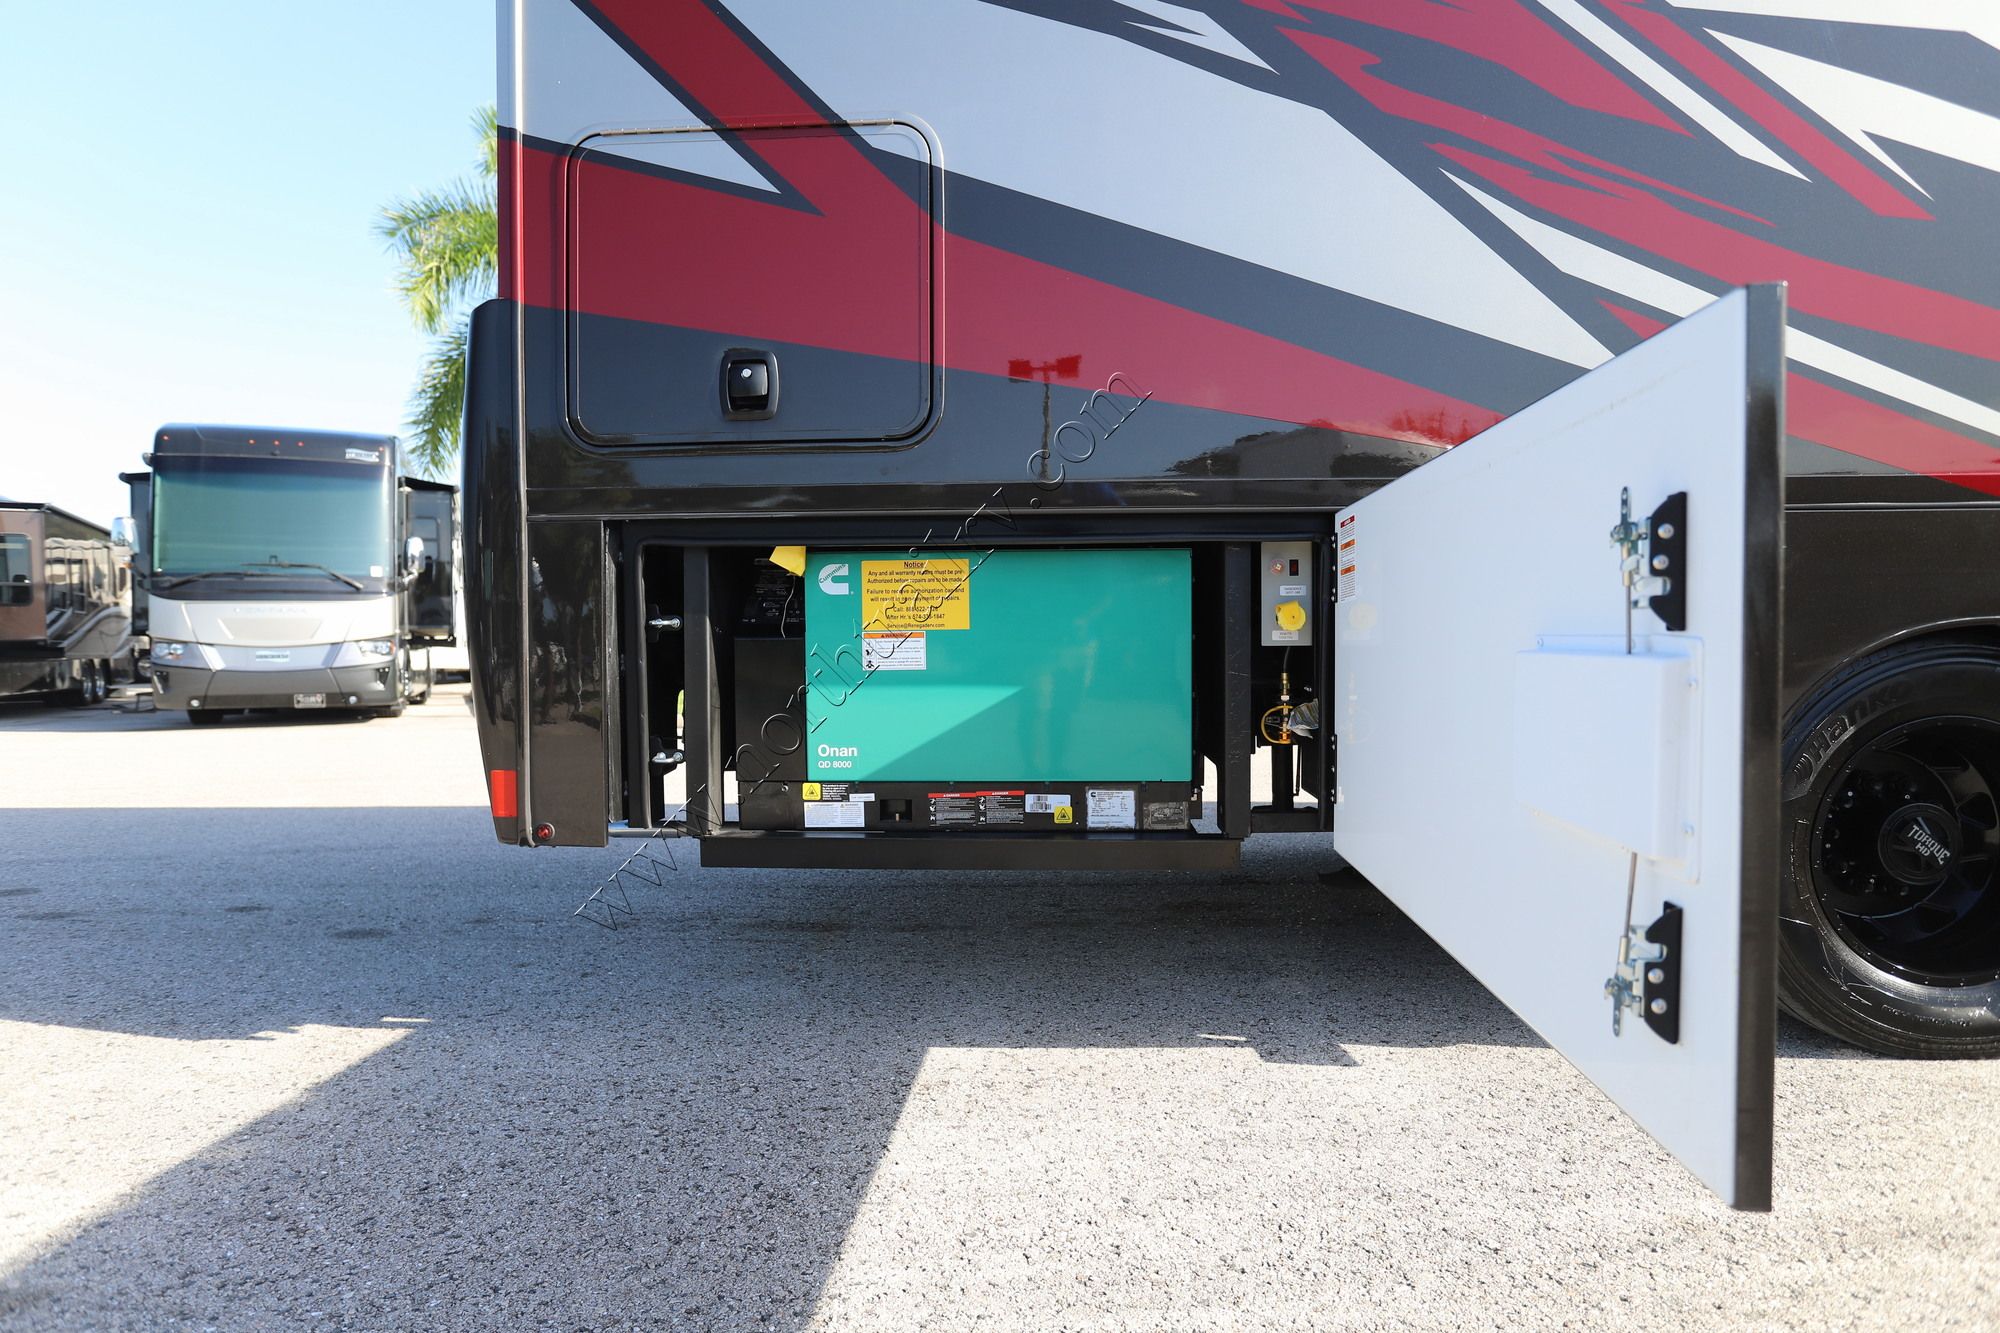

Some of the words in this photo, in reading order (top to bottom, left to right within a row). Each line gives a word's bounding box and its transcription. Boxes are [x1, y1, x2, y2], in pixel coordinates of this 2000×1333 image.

[819, 564, 846, 583] Cummins
[817, 744, 858, 757] Onan
[818, 760, 831, 769] QD
[832, 760, 852, 768] 8000
[1907, 824, 1951, 865] TORQUE
[1915, 842, 1931, 856] HD
